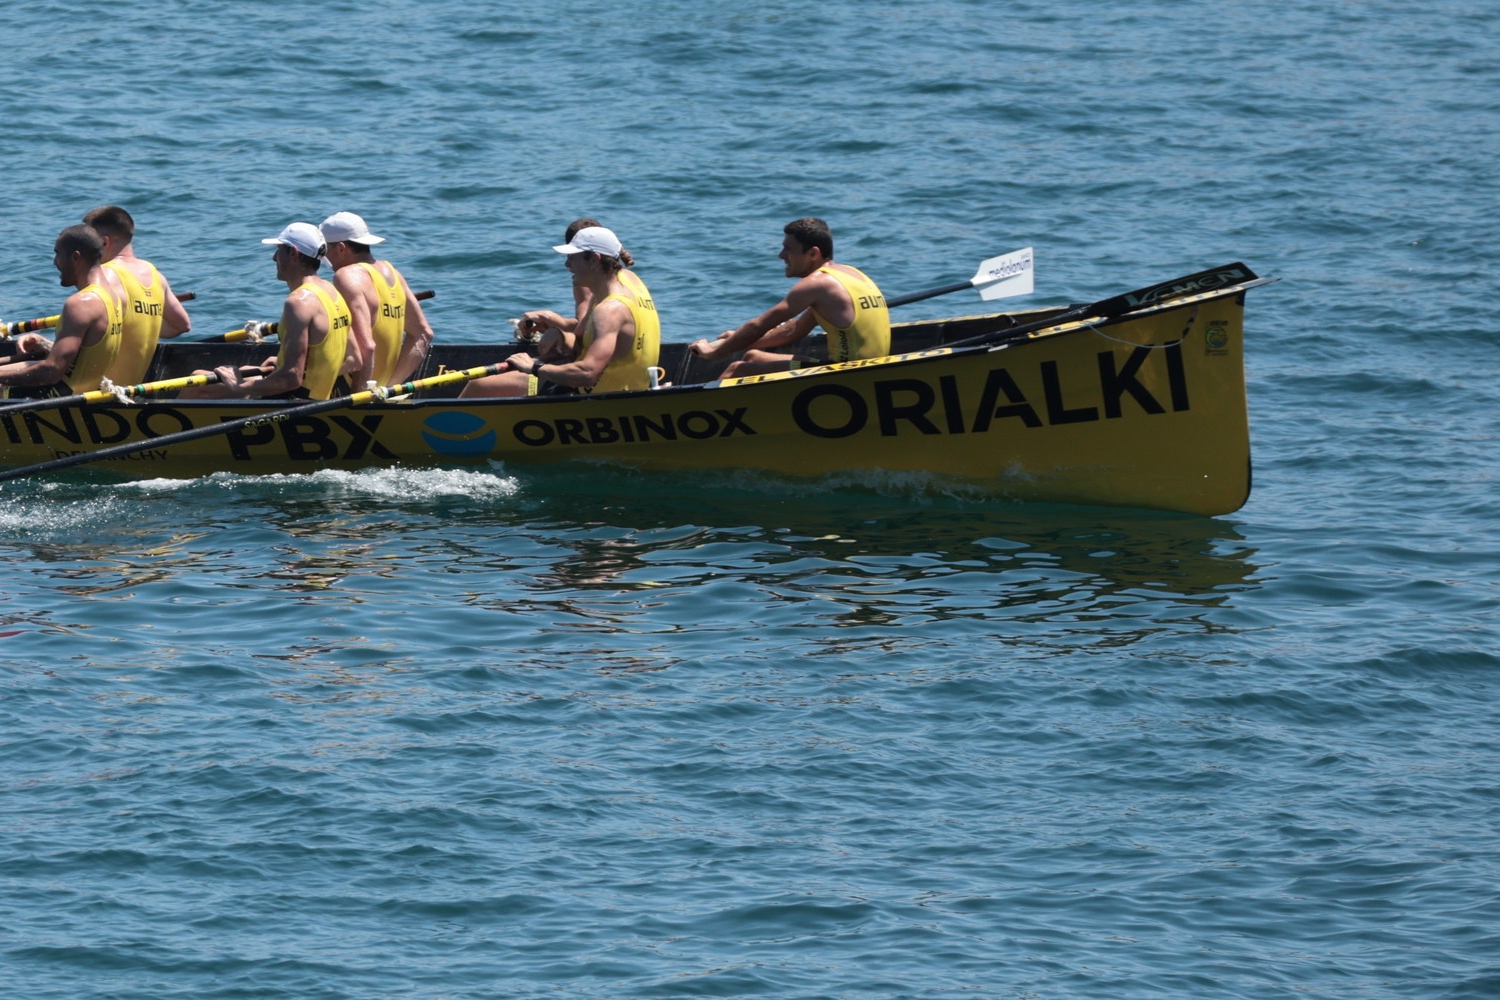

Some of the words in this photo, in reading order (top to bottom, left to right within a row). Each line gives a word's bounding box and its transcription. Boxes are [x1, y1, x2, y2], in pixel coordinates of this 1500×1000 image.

[988, 259, 1032, 280] mediolanum
[736, 375, 776, 385] EL
[789, 347, 948, 377] VASKITO
[791, 338, 1190, 439] ORIALKI
[0, 406, 195, 445] INDO
[219, 414, 400, 462] PBX
[512, 406, 758, 447] ORBINOX
